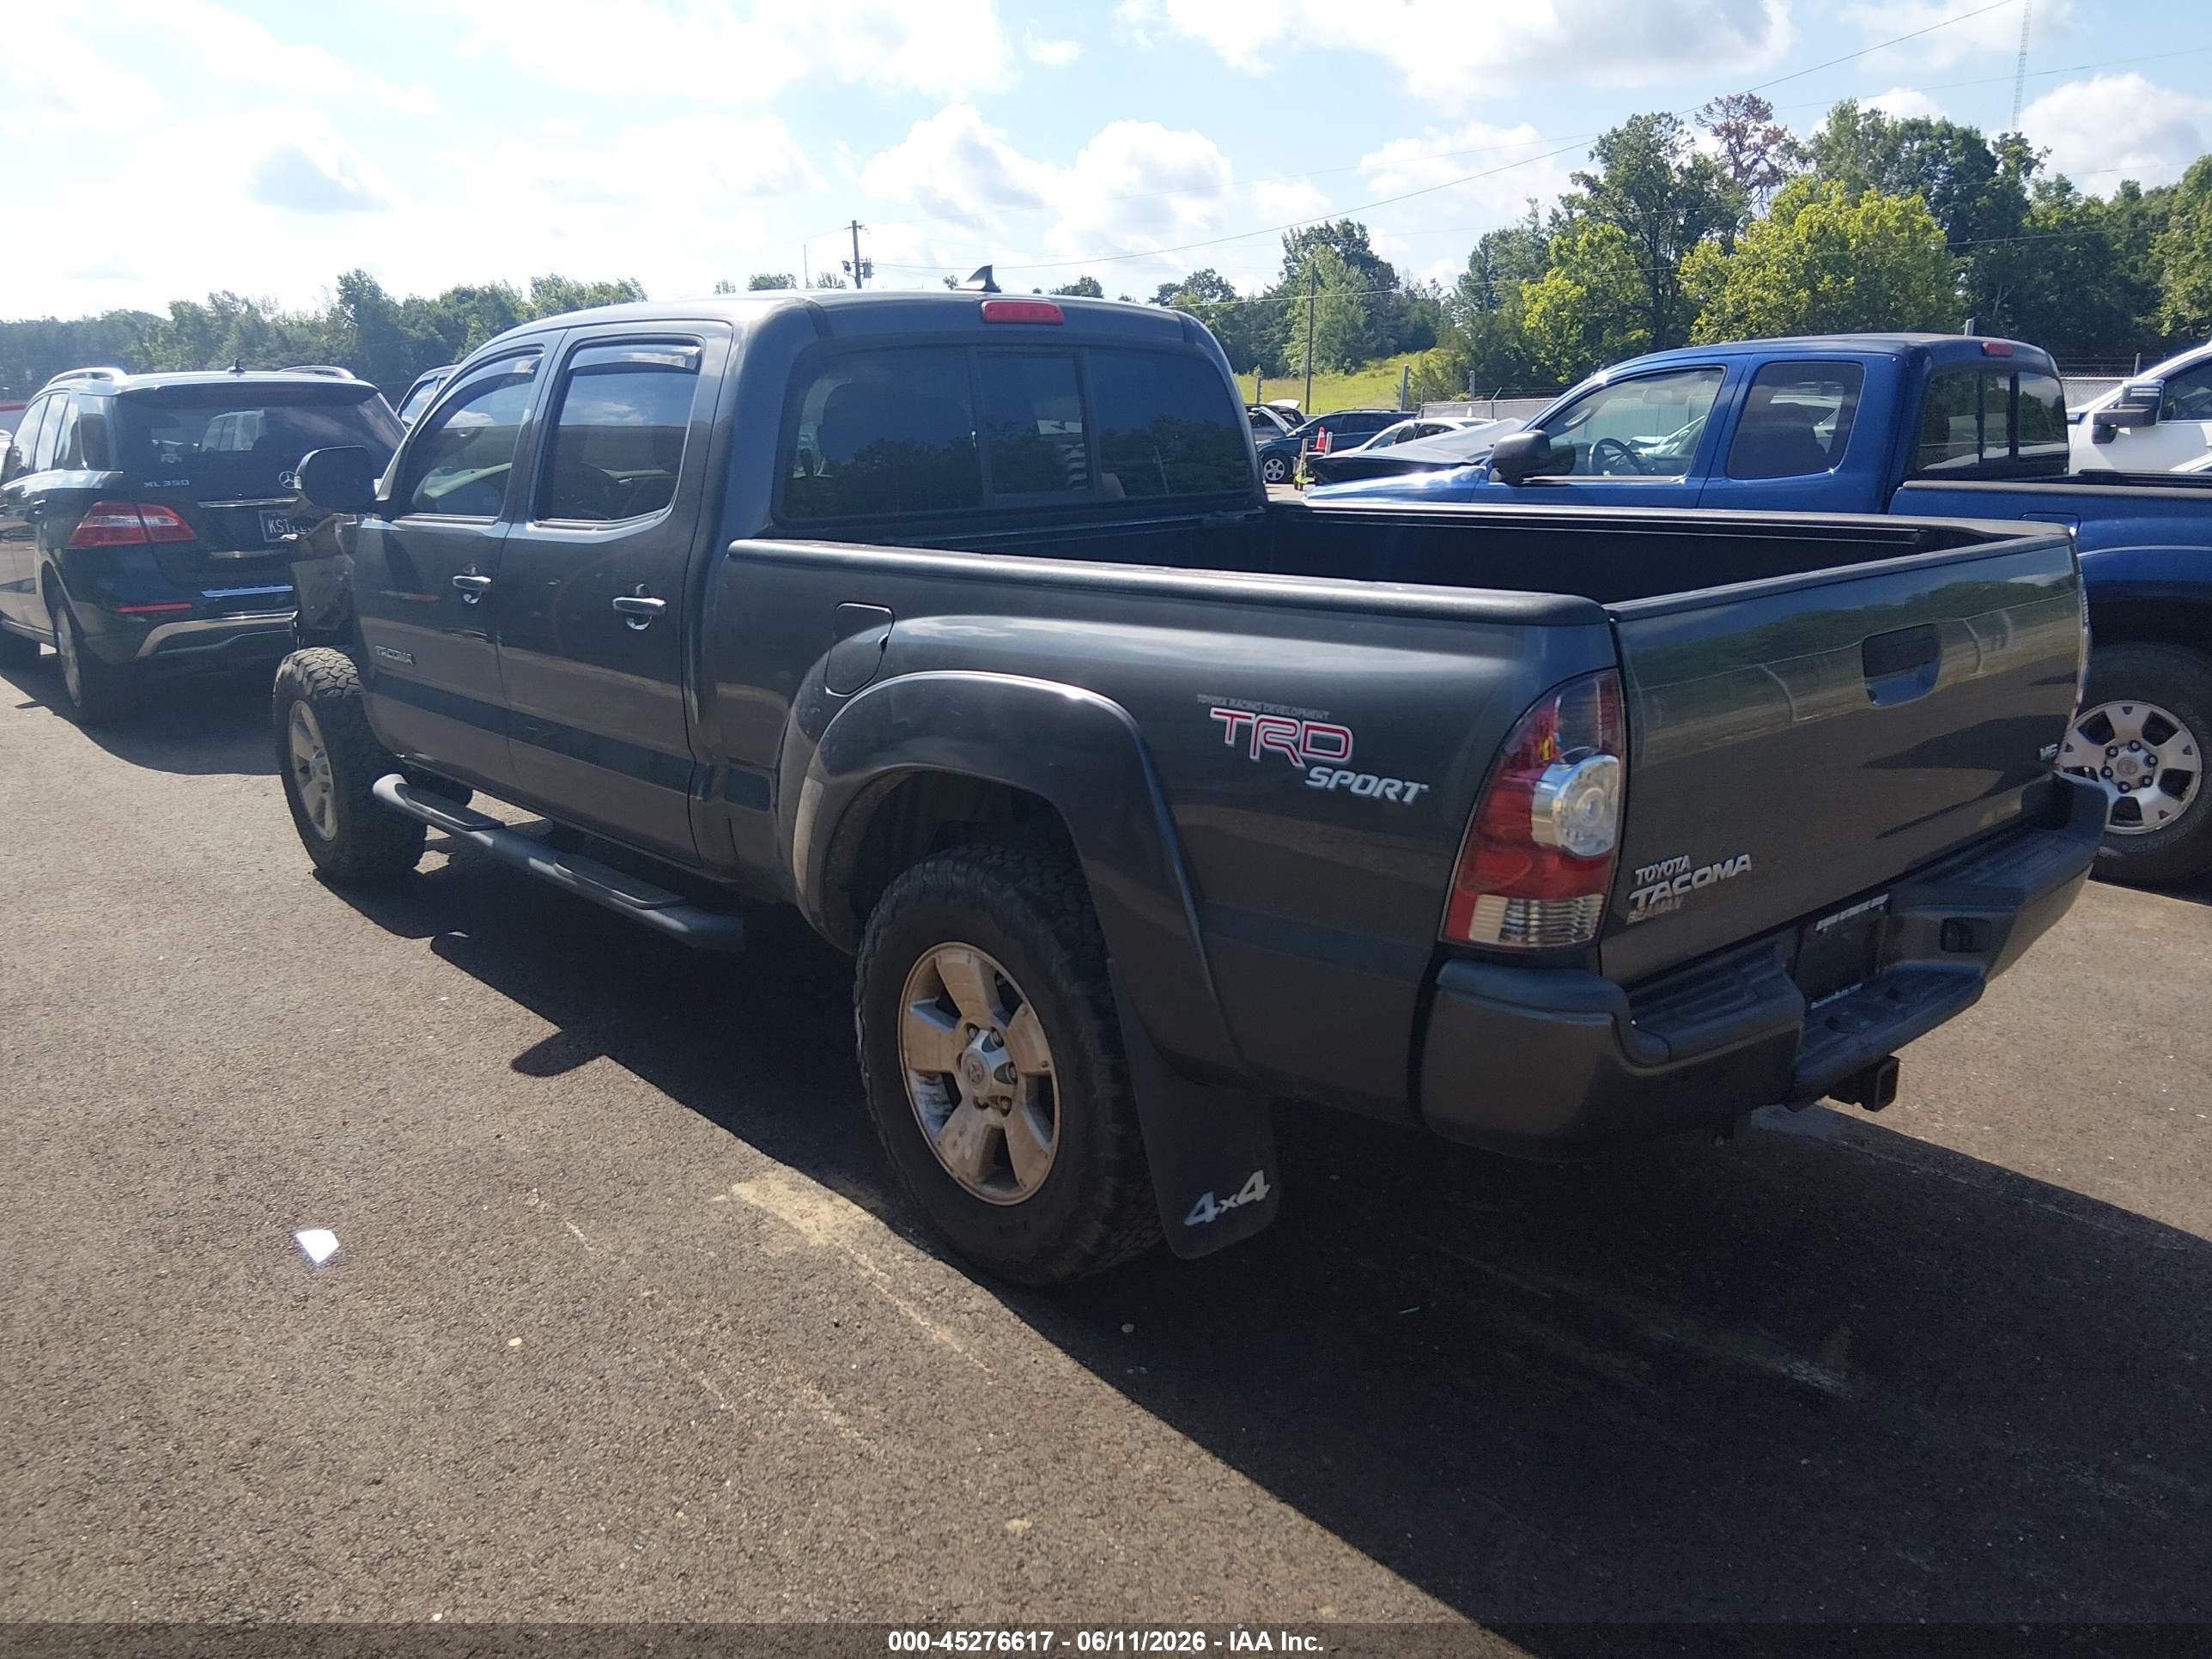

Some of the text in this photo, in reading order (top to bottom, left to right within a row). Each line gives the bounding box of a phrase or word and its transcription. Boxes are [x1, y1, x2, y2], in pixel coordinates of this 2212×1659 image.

[161, 479, 190, 488] 350
[1210, 707, 1354, 769] TRD
[1304, 766, 1430, 804] SPORT
[1628, 853, 1753, 908] TACOMA
[1634, 854, 1691, 886] TOYOTA
